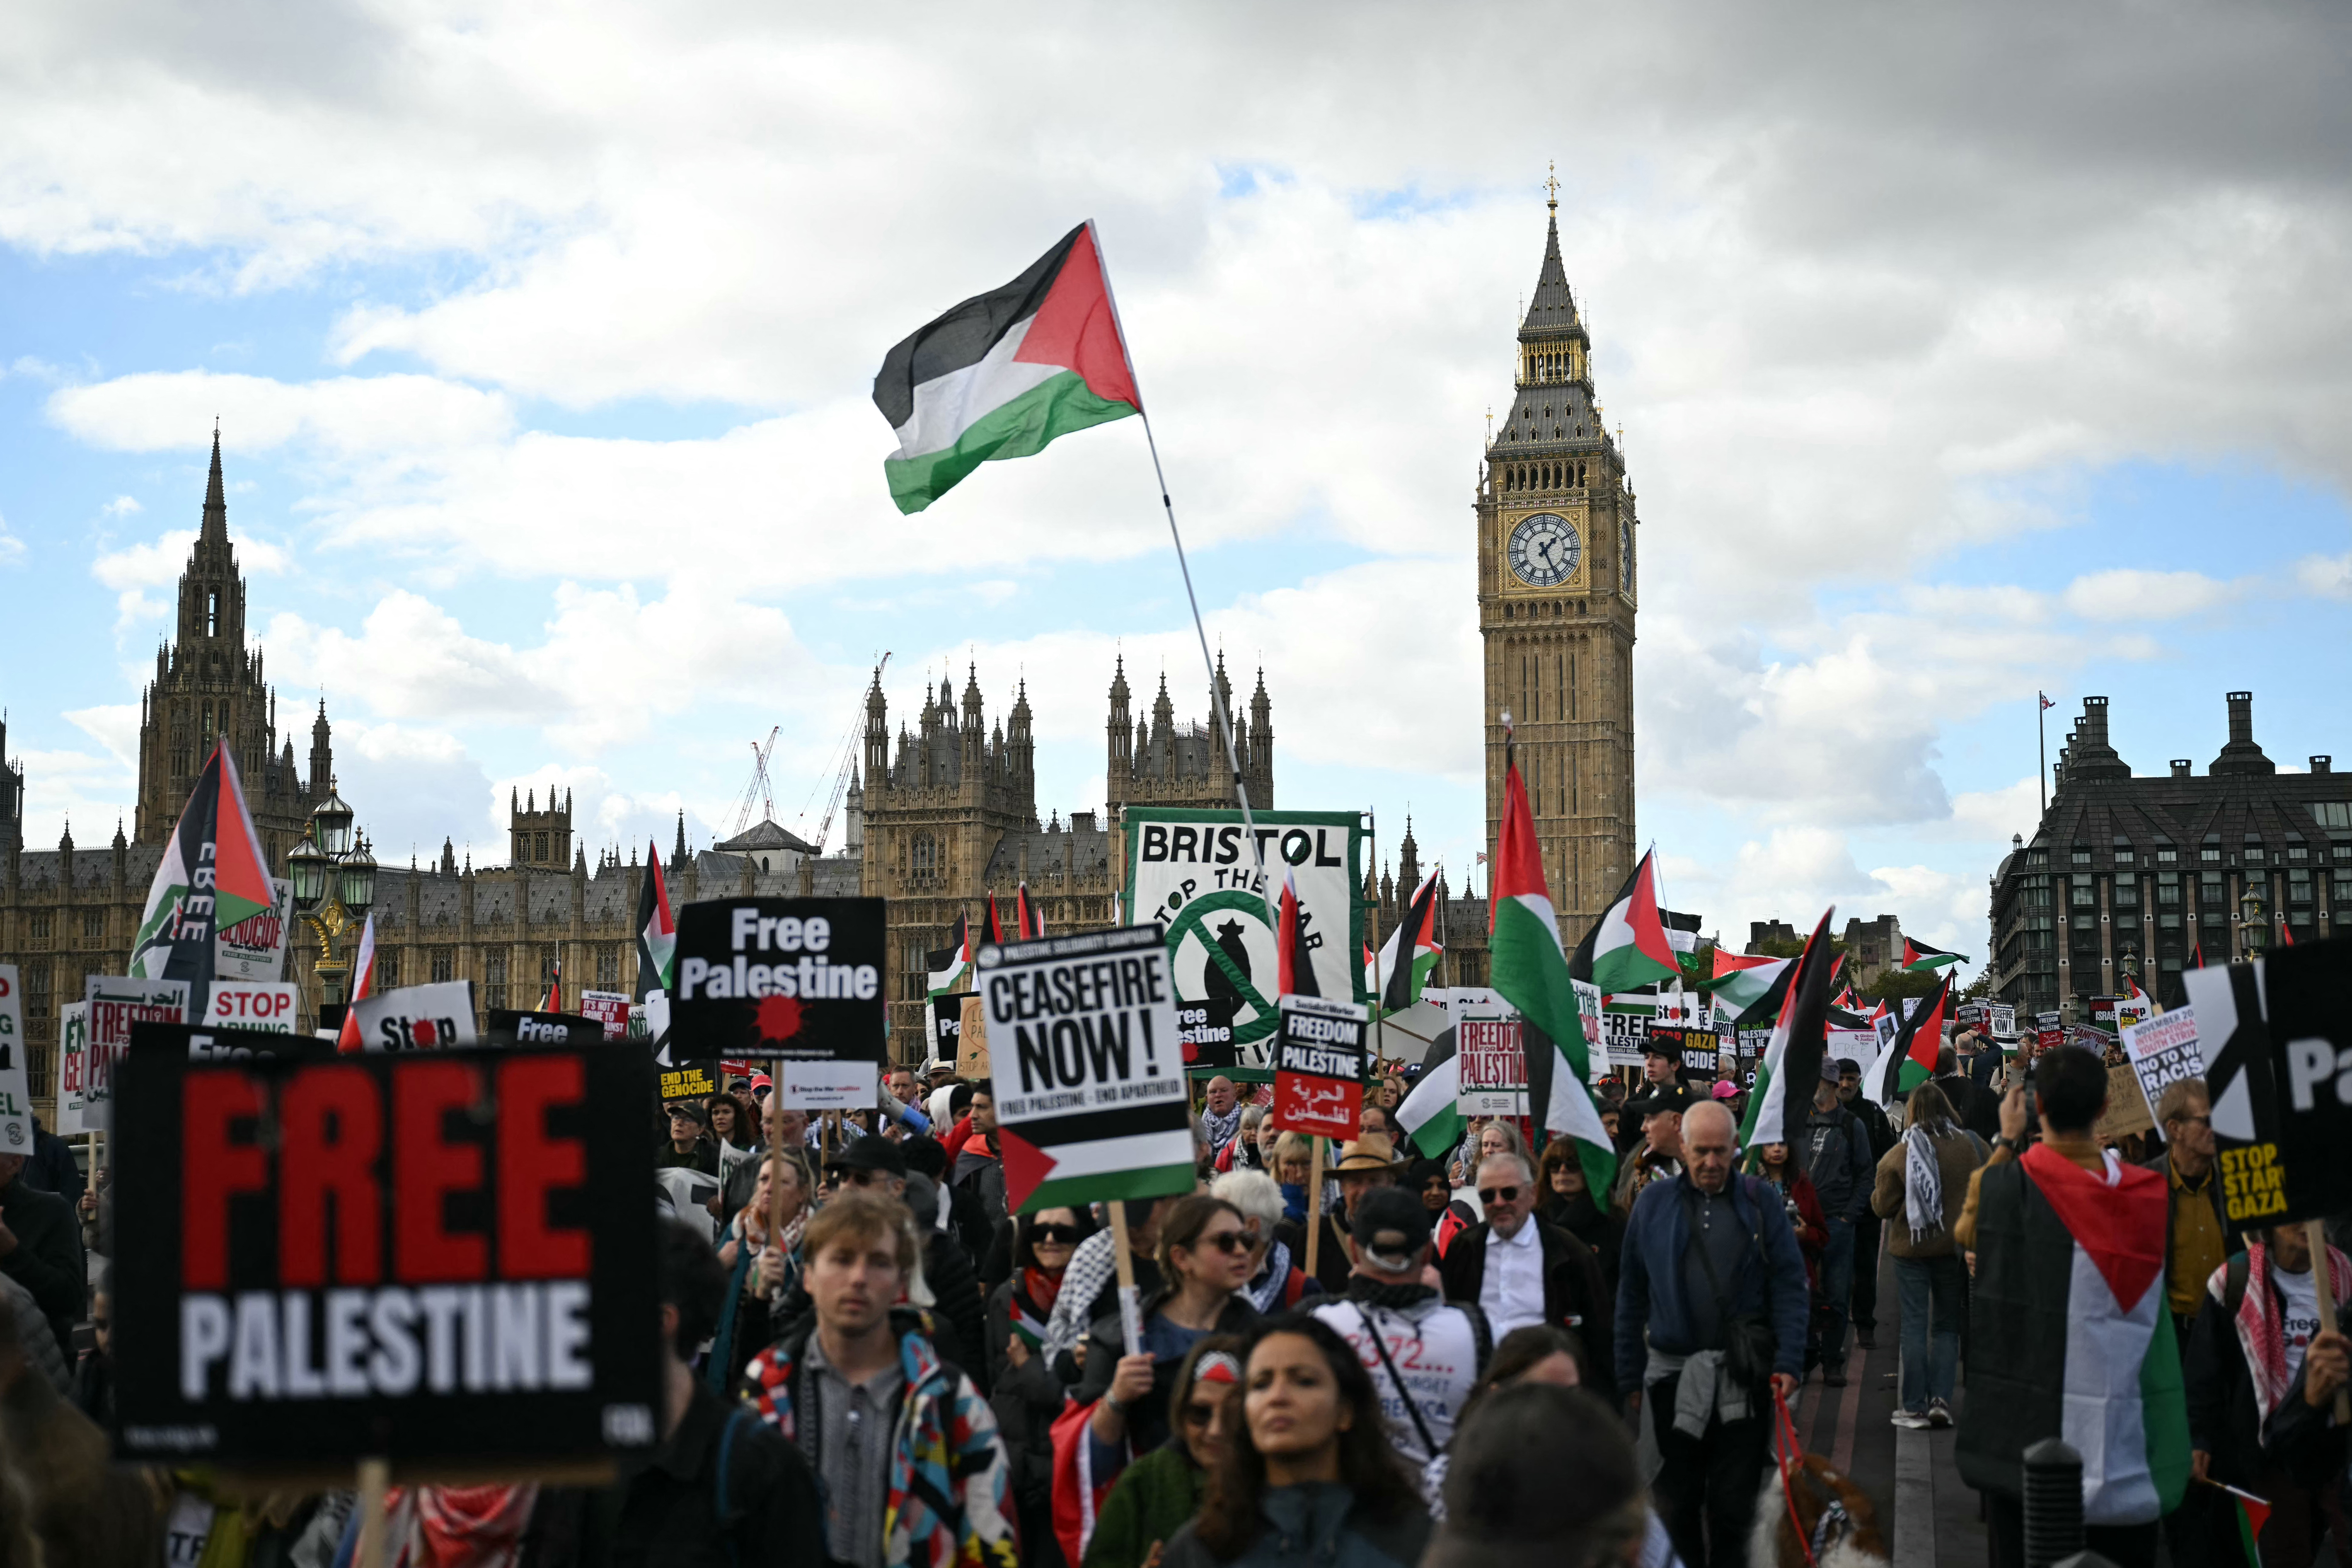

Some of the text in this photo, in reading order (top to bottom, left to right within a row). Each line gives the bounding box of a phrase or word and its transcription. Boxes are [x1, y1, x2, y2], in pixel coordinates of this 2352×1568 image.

[1142, 825, 1341, 867] BRISTOL
[1154, 878, 1196, 924] TOP
[1215, 868, 1268, 894] THE
[732, 908, 830, 951] Free
[239, 954, 271, 963] PALESTINE
[680, 956, 878, 1000] Palestine
[990, 955, 1165, 1025] CEASEFIRE
[215, 991, 290, 1017] STOP
[583, 1000, 618, 1012] IT'S NOT A
[1328, 1006, 1355, 1015] Worker
[1960, 1009, 1979, 1017] FREEDOM
[1991, 1008, 2013, 1019] CEASEFIRE
[583, 1010, 615, 1022] CRIME TO
[1175, 1008, 1207, 1025] ree
[2095, 1011, 2115, 1021] ISRAE
[2134, 1014, 2180, 1036] NOVEMBER
[517, 1016, 568, 1044] Free
[1287, 1014, 1358, 1046] FREEDOM
[1461, 1022, 1524, 1052] FREEDO
[1651, 1030, 1682, 1041] STOP
[1739, 1029, 1772, 1039] PALESTINE
[2073, 1027, 2110, 1045] SANCTION
[2135, 1018, 2196, 1047] INTERNATIONA
[1685, 1033, 1716, 1050] GAZA
[1739, 1038, 1765, 1048] WILL BE
[1740, 1048, 1756, 1057] FREE
[1834, 1043, 1868, 1056] FREE
[2138, 1039, 2168, 1057] YOUTH
[960, 1062, 978, 1072] STOP
[1282, 1045, 1360, 1079] PALESTINE
[2137, 1057, 2159, 1075] NO
[2160, 1049, 2179, 1066] TO
[661, 1069, 703, 1086] END THE
[2143, 1057, 2204, 1091] RACIS
[662, 1080, 714, 1098] GENOCIDE
[1000, 1079, 1180, 1118] FREE PALESTINE END APARTHEID
[1284, 1103, 1350, 1125] لفلسطين
[2221, 1142, 2278, 1174] STOP
[180, 1055, 592, 1290] FREE
[2227, 1190, 2288, 1220] GAZA
[179, 1280, 593, 1401] PALESTINE
